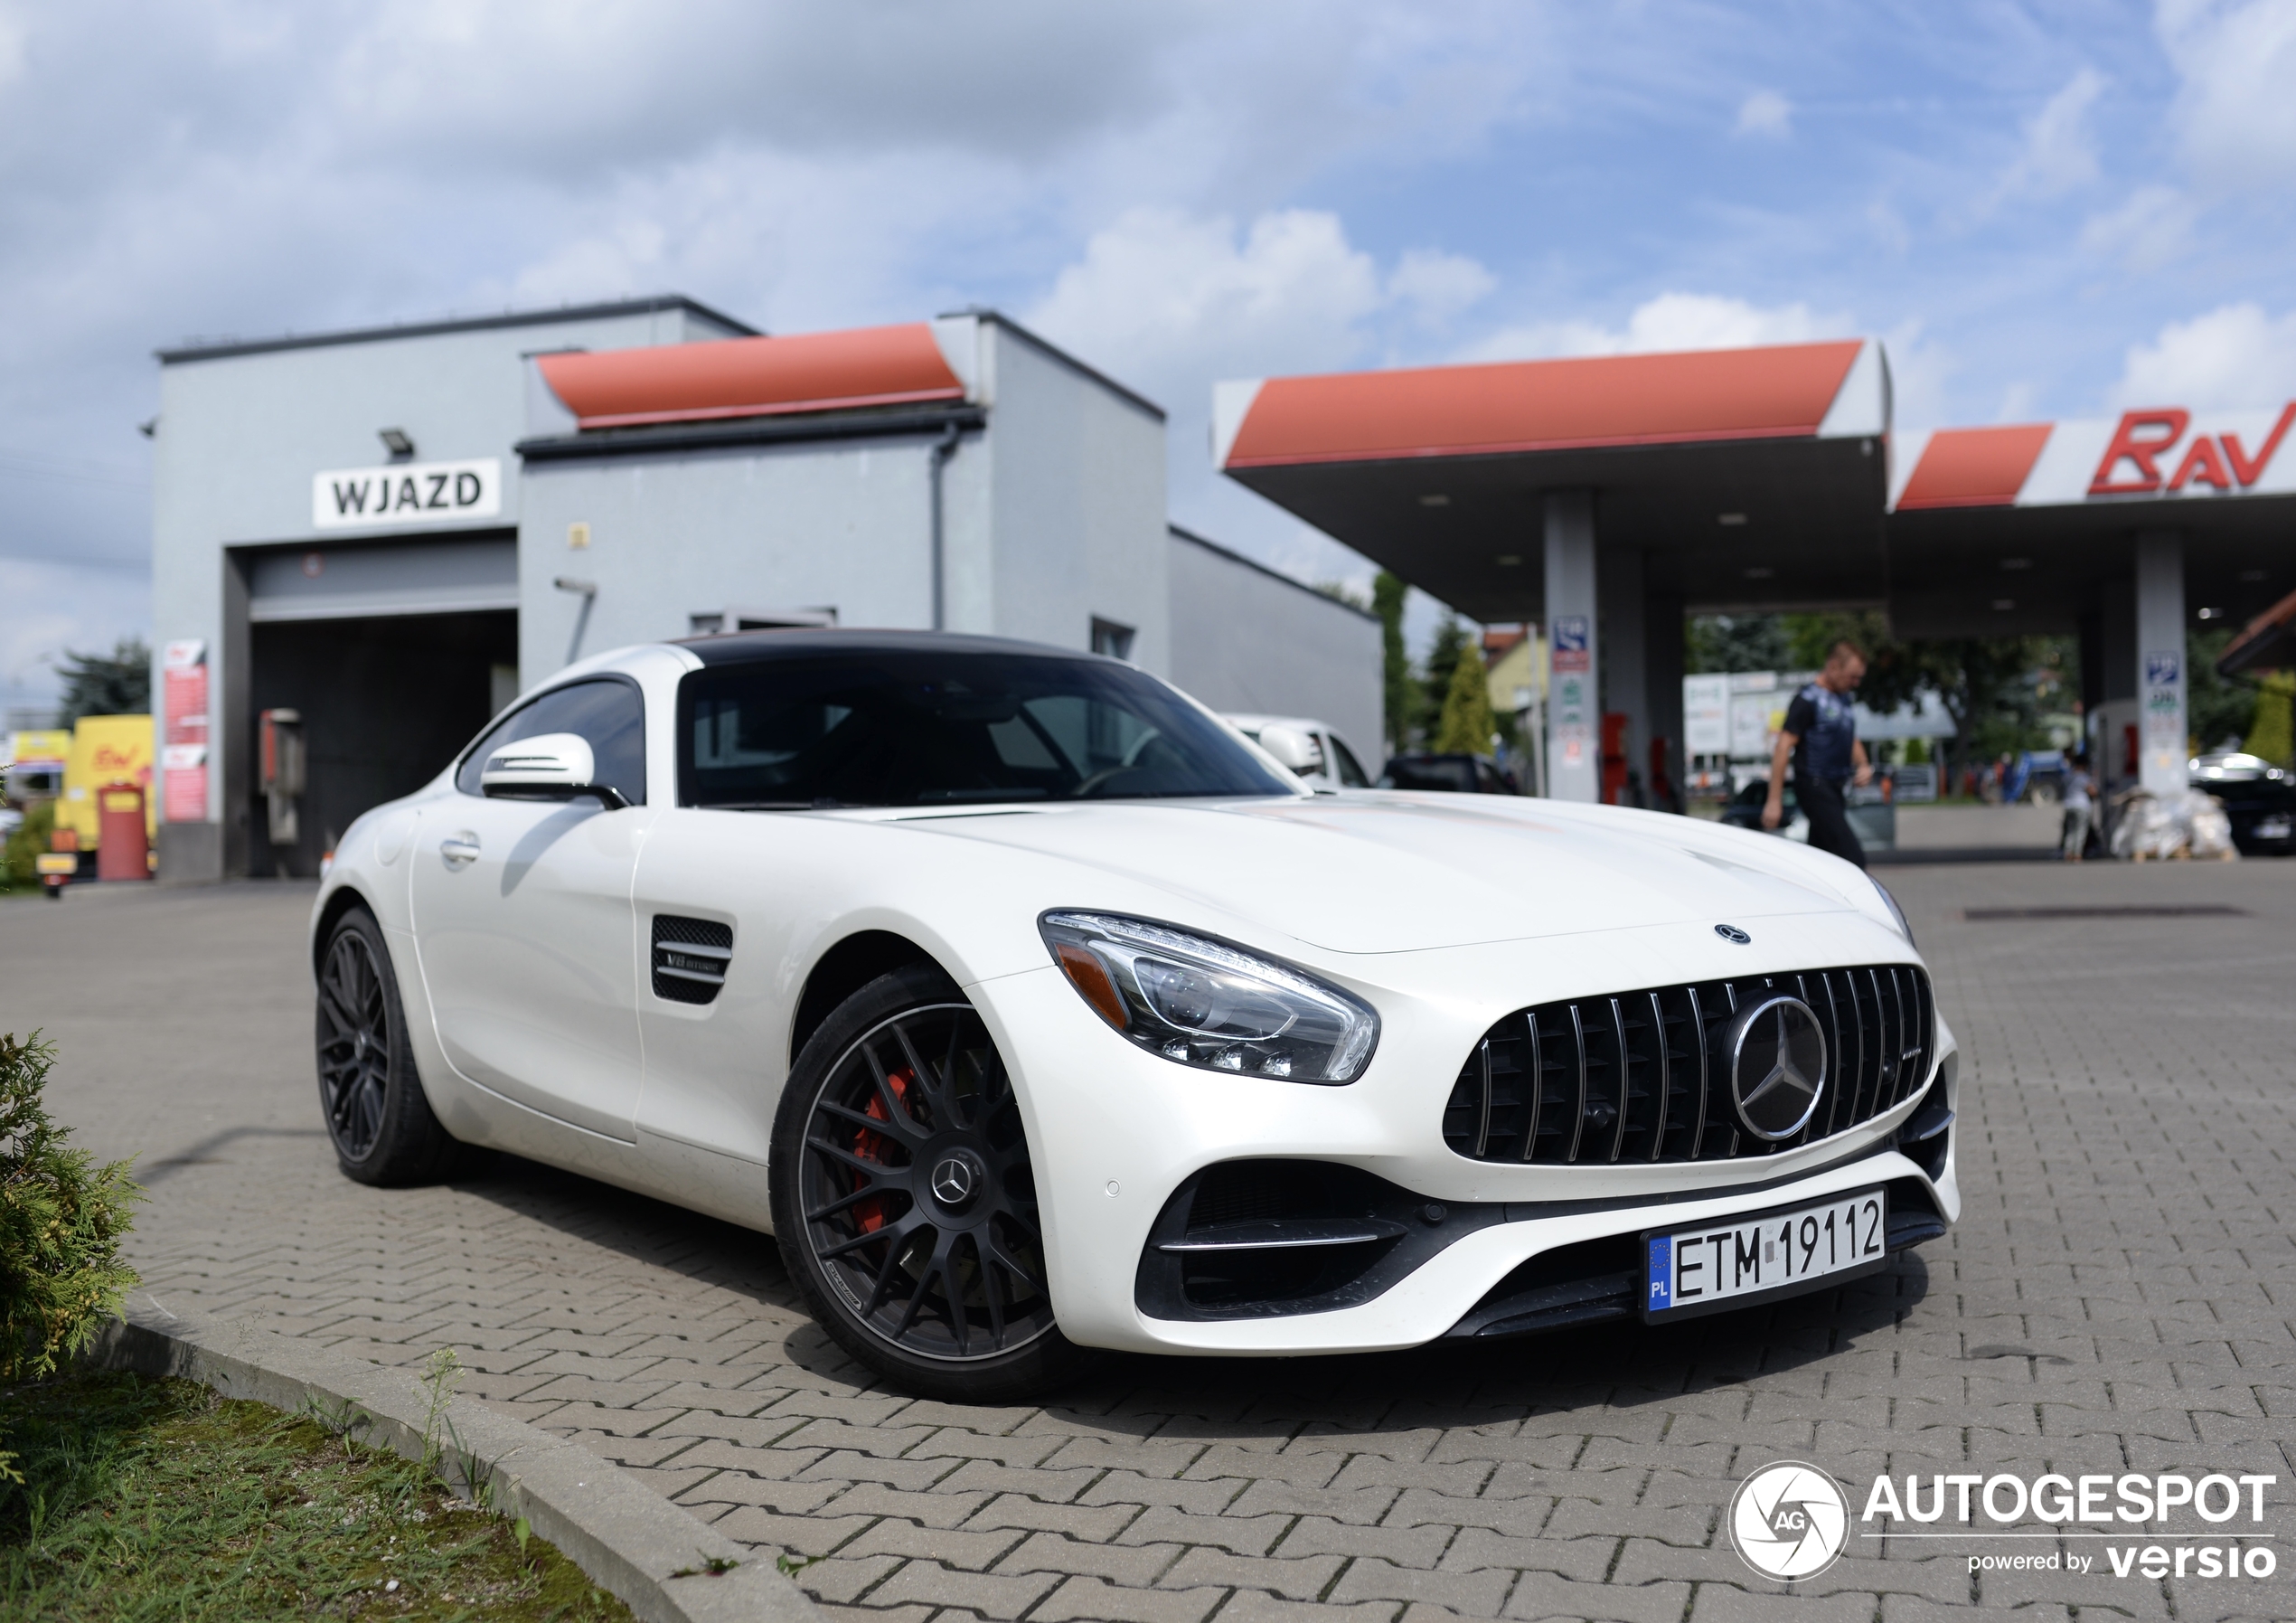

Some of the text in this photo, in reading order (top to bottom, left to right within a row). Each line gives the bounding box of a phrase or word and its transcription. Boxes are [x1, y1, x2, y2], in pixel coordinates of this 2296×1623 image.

[333, 472, 482, 514] WJAZD
[666, 952, 686, 968] V8
[1676, 1199, 1880, 1298] ETM 19112
[1651, 1280, 1668, 1298] PL
